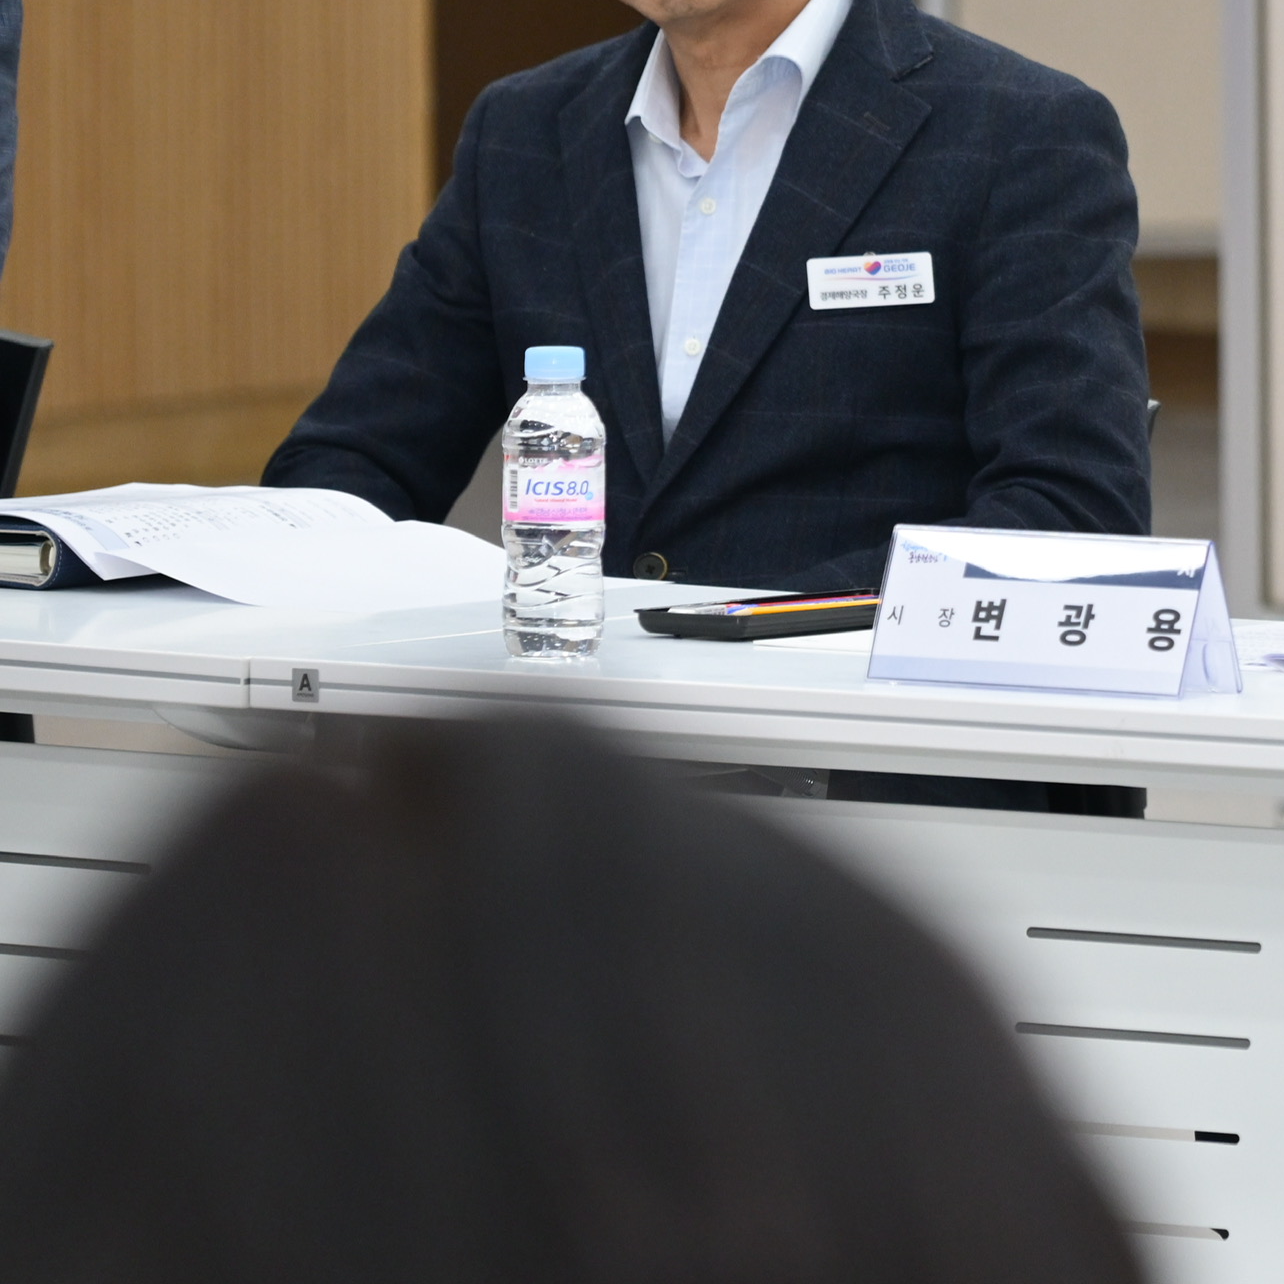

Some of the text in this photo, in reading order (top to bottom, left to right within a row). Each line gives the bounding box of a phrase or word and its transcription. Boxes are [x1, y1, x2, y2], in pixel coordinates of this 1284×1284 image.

[883, 263, 916, 273] GEOJE
[878, 283, 925, 300] 주정운
[525, 478, 589, 496] ICIS 8.0
[299, 673, 312, 692] A
